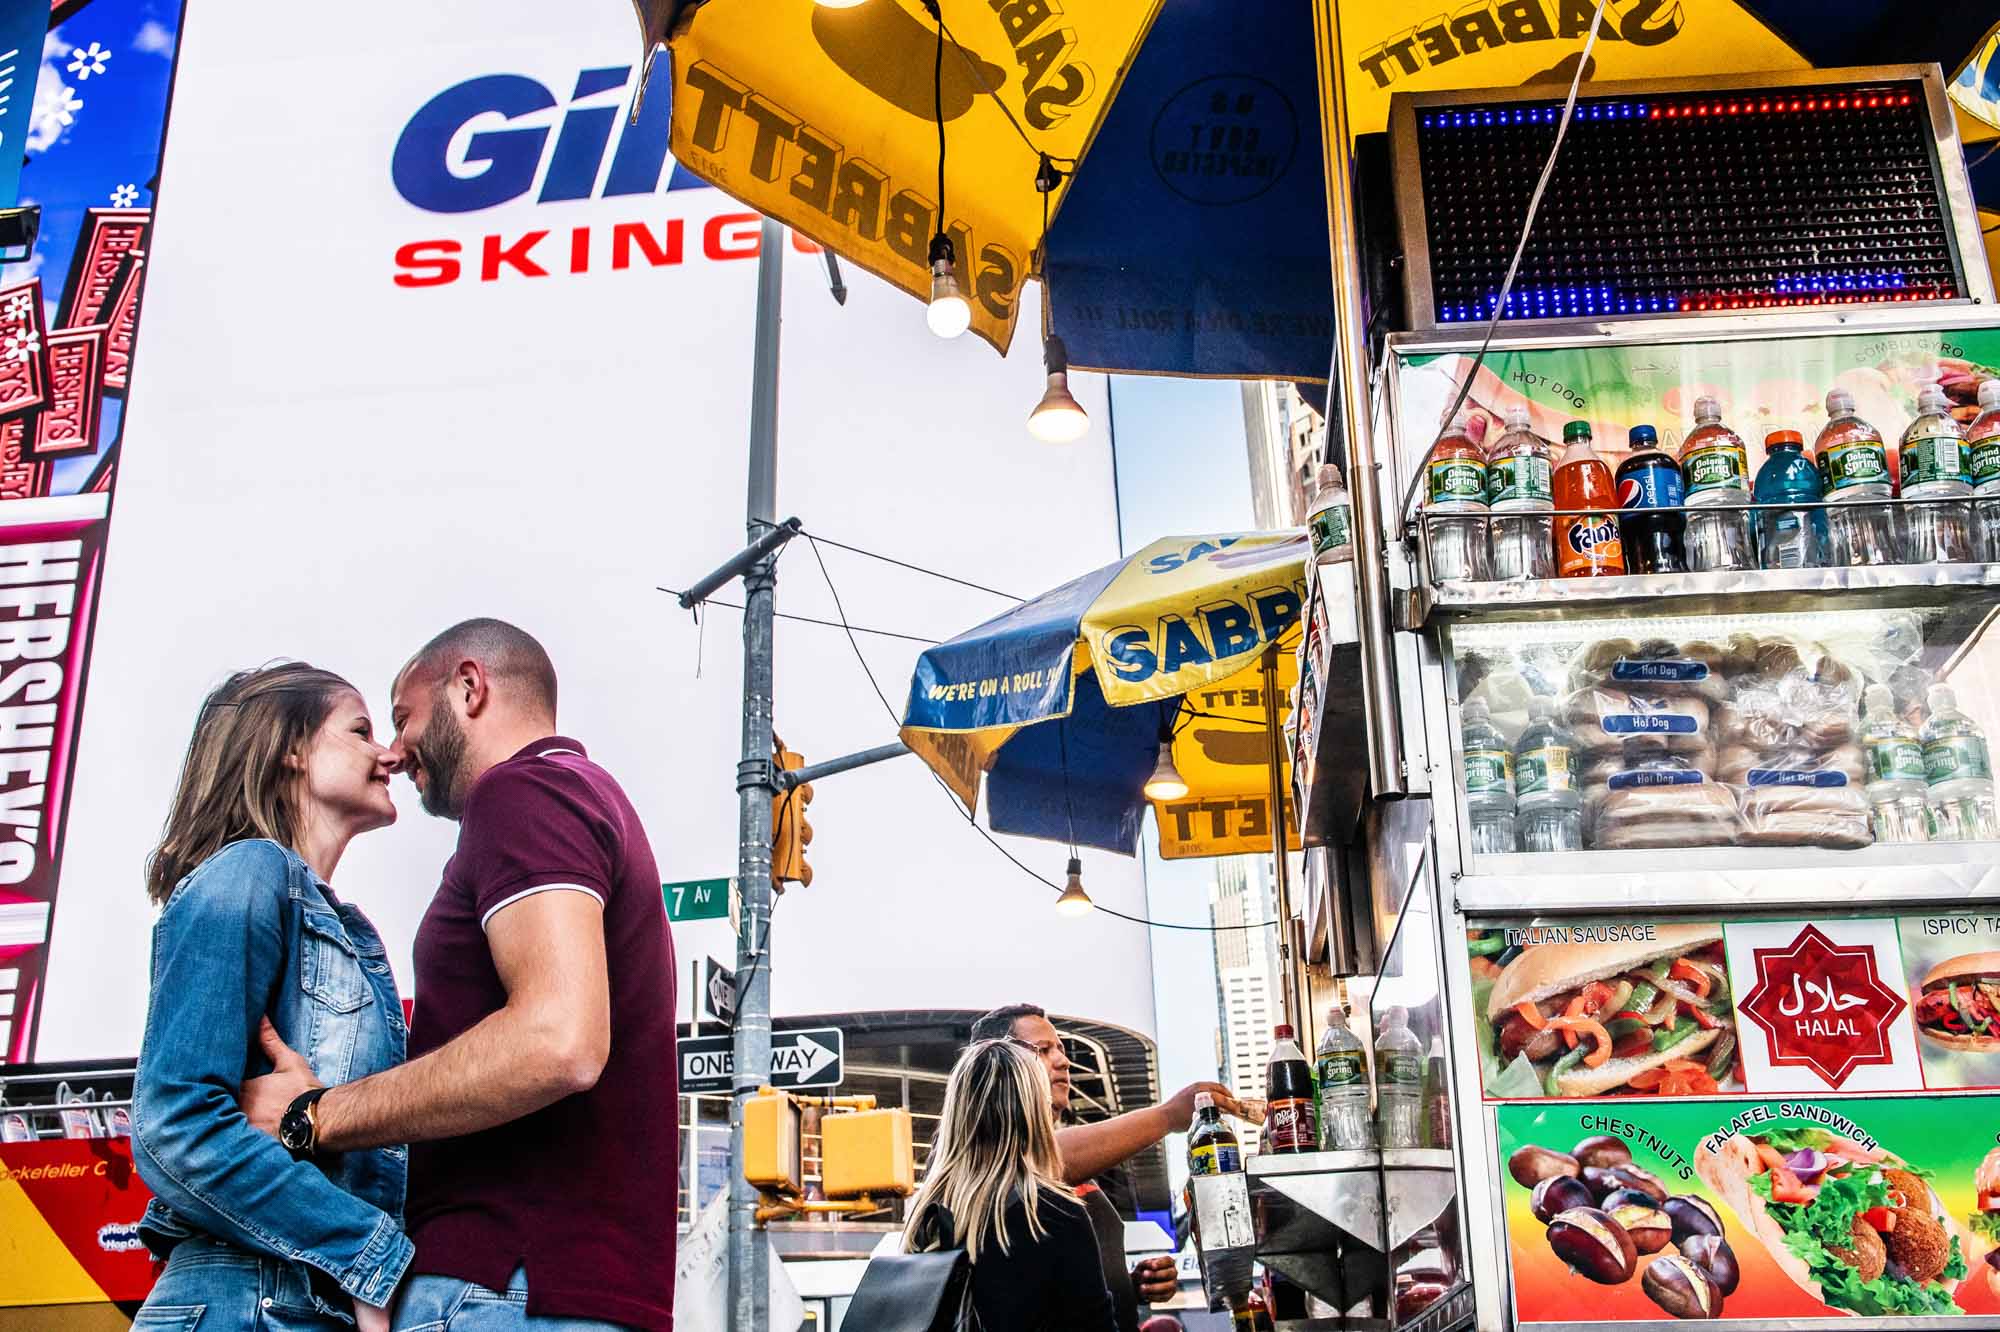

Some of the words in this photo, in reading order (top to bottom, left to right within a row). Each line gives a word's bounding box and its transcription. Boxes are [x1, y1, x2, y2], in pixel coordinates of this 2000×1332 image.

[393, 212, 826, 288] SKING
[1512, 371, 1548, 387] HOT
[1551, 382, 1585, 409] DOG
[1693, 464, 1731, 482] Spring
[1845, 460, 1881, 476] Spring
[1445, 477, 1480, 492] Spring
[1568, 519, 1620, 554] Fanta
[1102, 577, 1309, 682] SABR
[1659, 663, 1678, 679] Dog
[929, 681, 976, 701] WE'RE
[980, 678, 998, 697] ON
[1001, 676, 1009, 694] A
[1013, 670, 1042, 693] ROLL
[1632, 716, 1649, 728] Hot
[1651, 716, 1670, 730] Dog
[1465, 767, 1494, 781] pring
[1656, 772, 1675, 786] Dog
[672, 887, 685, 917] 7
[694, 885, 712, 903] Av
[1505, 927, 1568, 945] ITALIAN
[1573, 925, 1657, 942] SAUSAGE
[1922, 918, 1979, 935] ISPICY
[1778, 972, 1869, 1016] حلال
[1795, 1018, 1861, 1037] HALAL
[690, 1051, 734, 1076] ONE
[1705, 1105, 1776, 1154] FALAFEL
[1780, 1103, 1878, 1152] SANDWICH
[1580, 1114, 1694, 1182] CHESTNUTS
